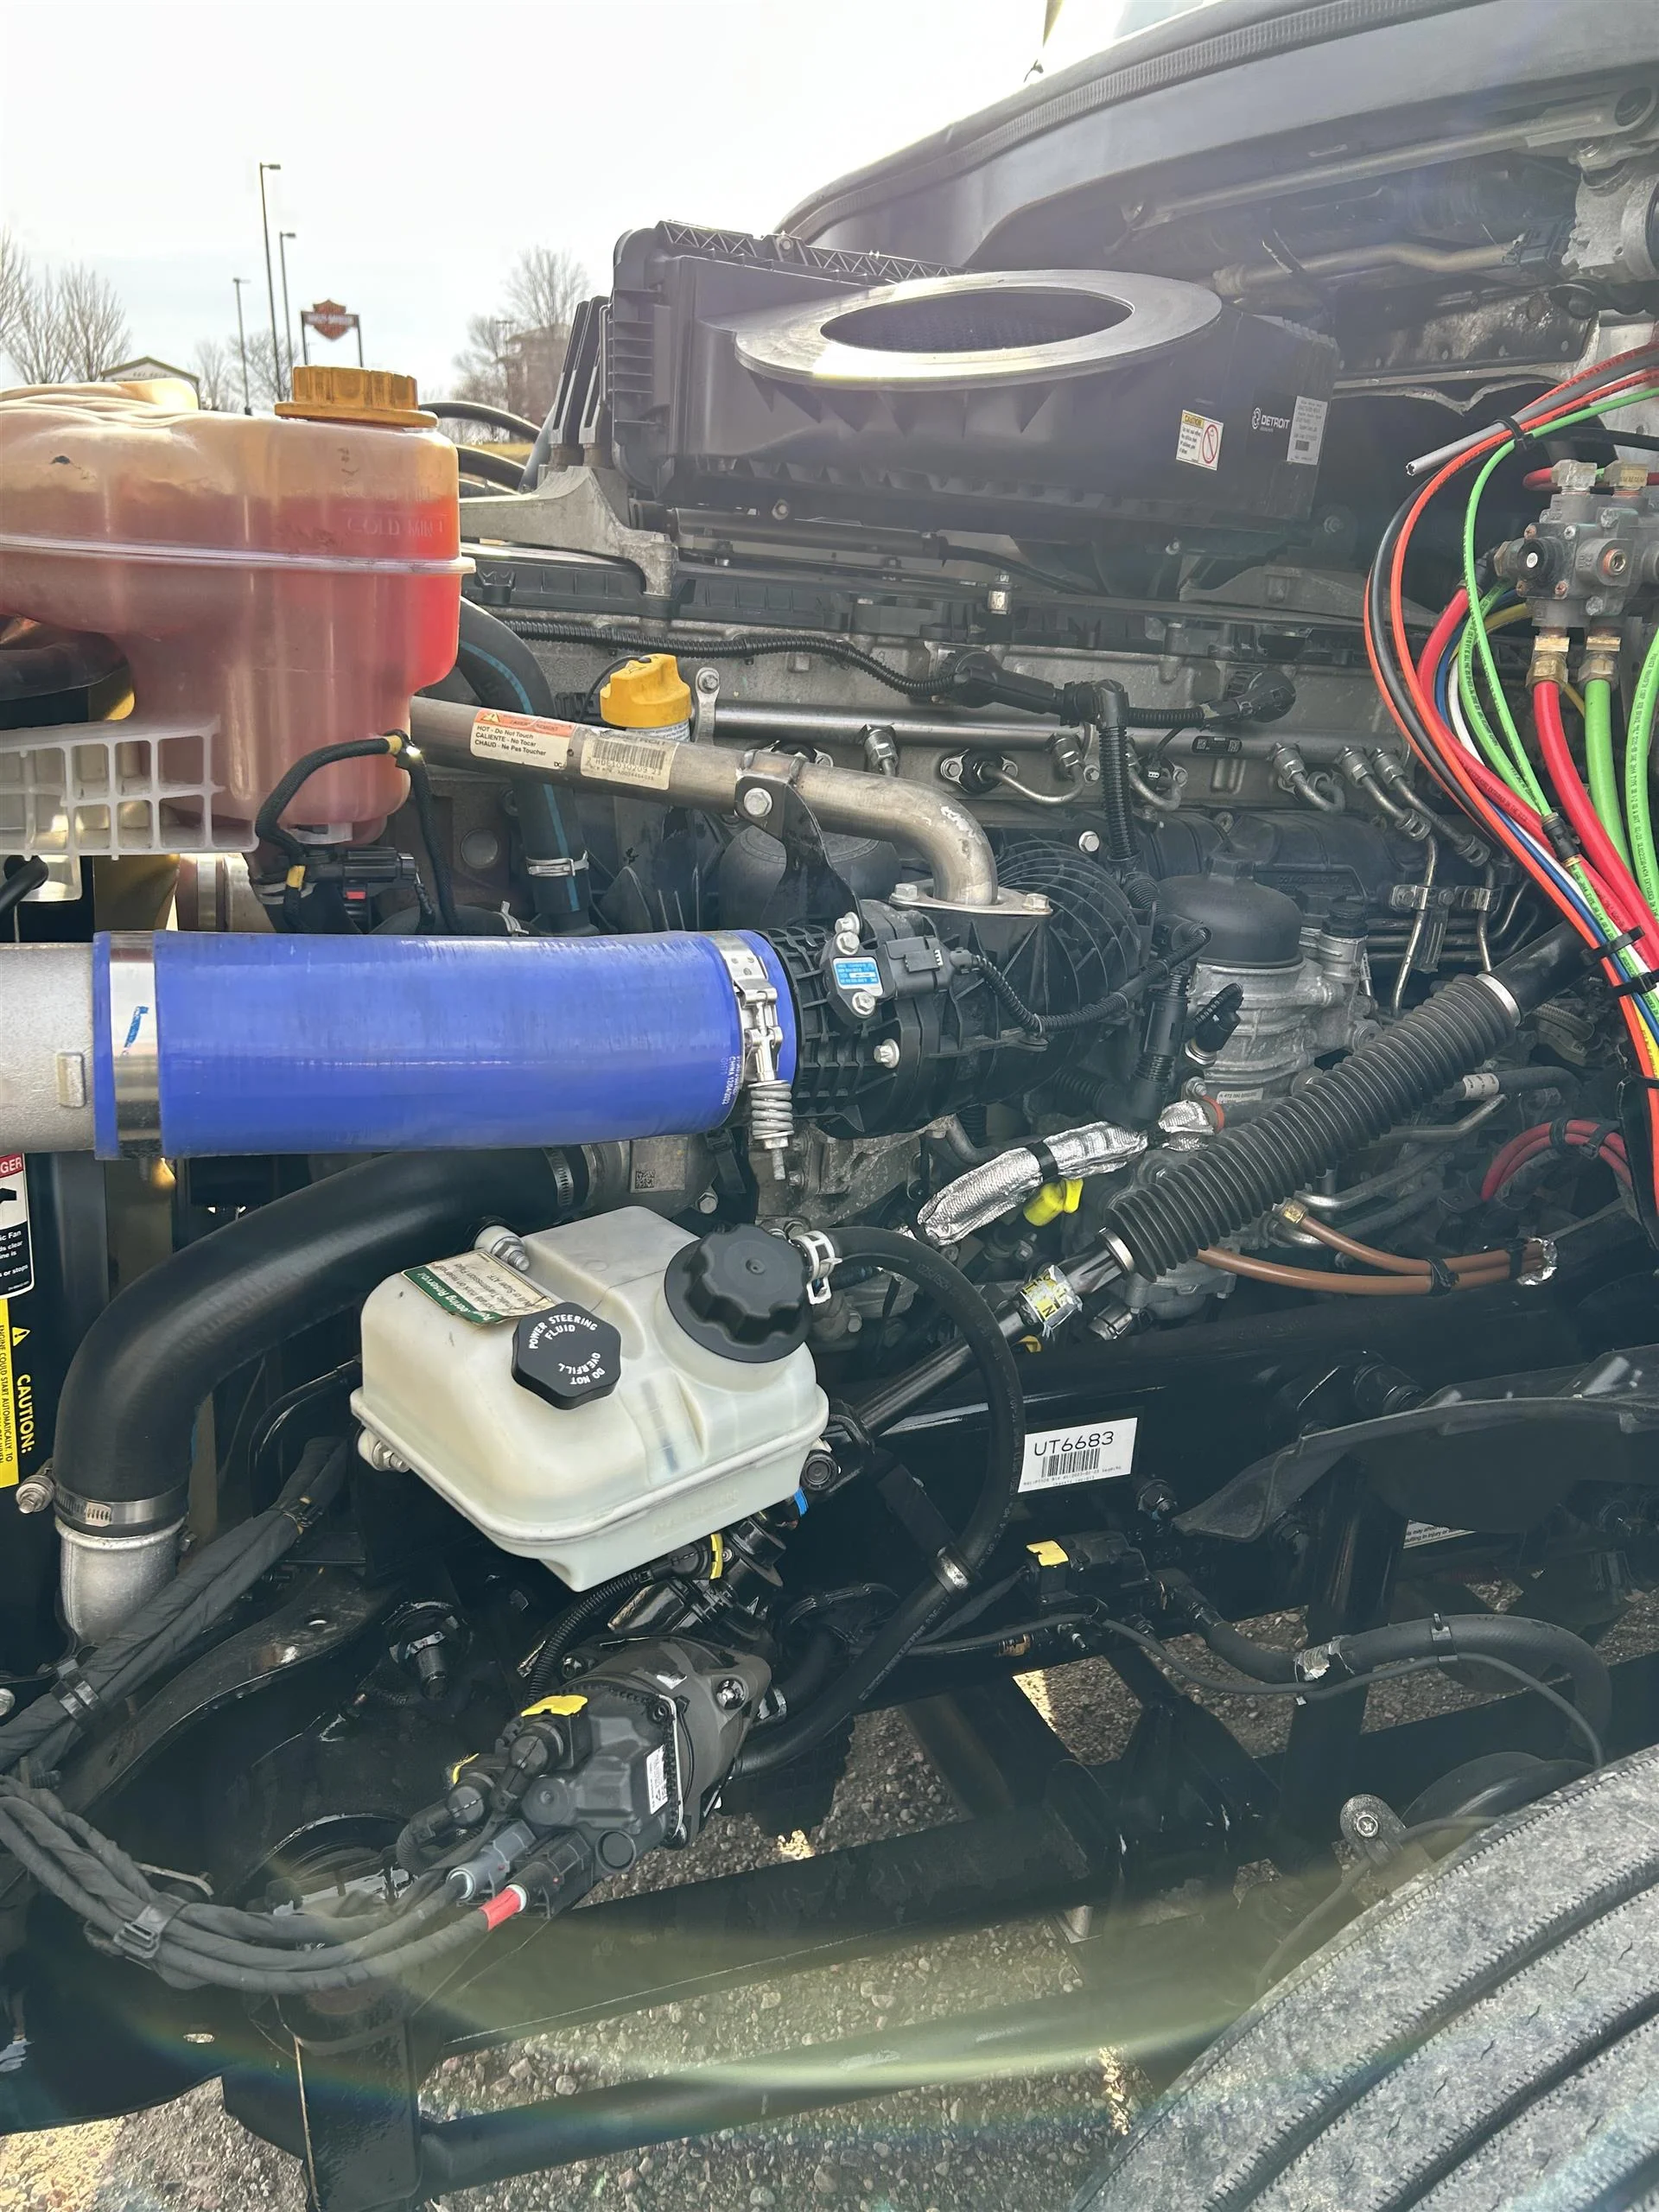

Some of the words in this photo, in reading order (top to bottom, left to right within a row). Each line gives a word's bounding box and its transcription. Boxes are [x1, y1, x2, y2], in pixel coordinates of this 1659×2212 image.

[1262, 415, 1290, 429] DETROIT
[475, 732, 506, 742] CALIENTE
[520, 739, 537, 747] Tocar
[516, 731, 534, 740] Touch
[474, 739, 497, 748] CHAUD
[522, 747, 547, 756] Toucher
[0, 1156, 22, 1173] GER
[8, 1230, 22, 1239] Fan
[8, 1241, 23, 1250] clear
[12, 1264, 29, 1274] stops
[416, 1272, 450, 1297] Reservoir
[529, 1322, 548, 1350] POWER
[548, 1314, 598, 1331] STEERING
[544, 1324, 576, 1340] FLUID
[557, 1352, 601, 1375] OVERFILL
[570, 1375, 591, 1385] NOT
[591, 1367, 606, 1379] DO
[1, 1376, 10, 1396] START
[17, 1374, 35, 1453] CAUTION:
[1033, 1431, 1115, 1456] UT6683
[5, 1452, 14, 1463] TO
